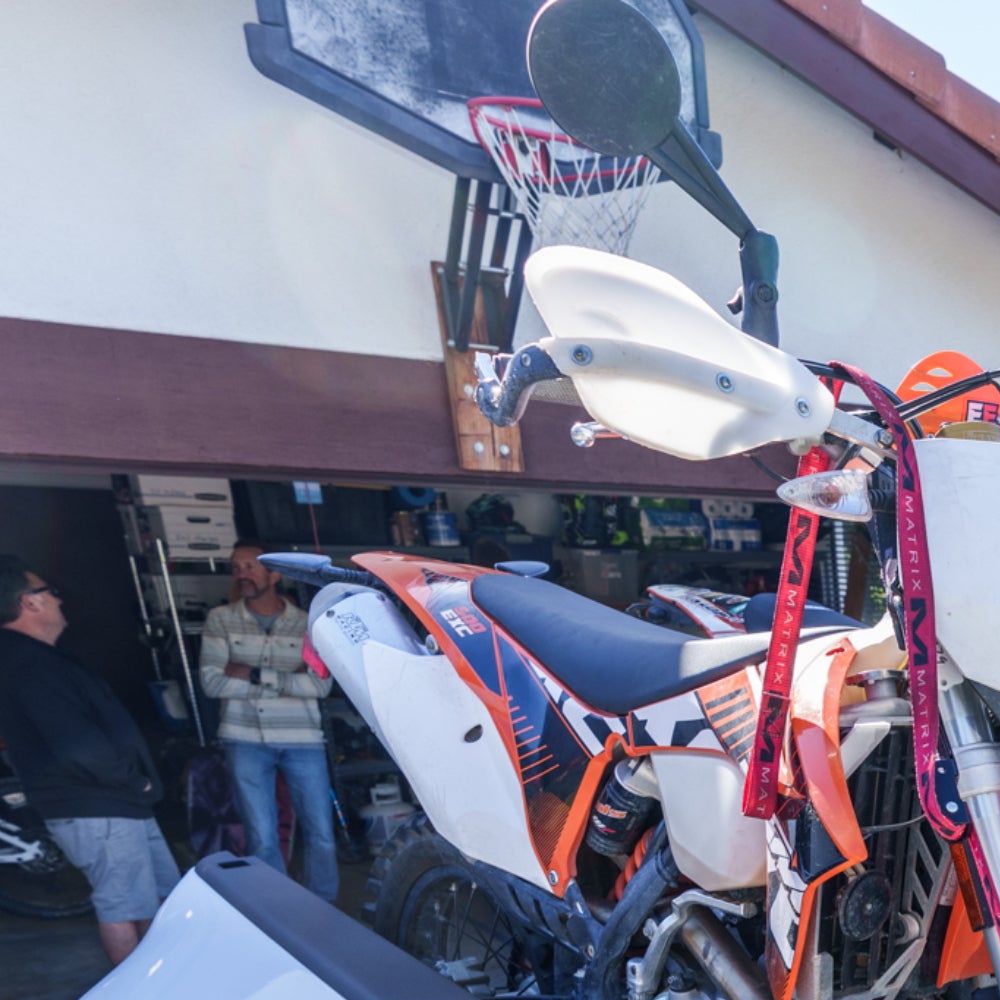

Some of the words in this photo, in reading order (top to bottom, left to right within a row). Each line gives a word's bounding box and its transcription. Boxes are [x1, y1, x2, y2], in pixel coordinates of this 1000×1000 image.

[904, 495, 922, 592] MATRIX
[440, 608, 475, 638] EXC
[453, 605, 487, 634] 500
[772, 588, 797, 685] MATRIX
[915, 668, 931, 770] MATRIX
[756, 766, 771, 816] MAT
